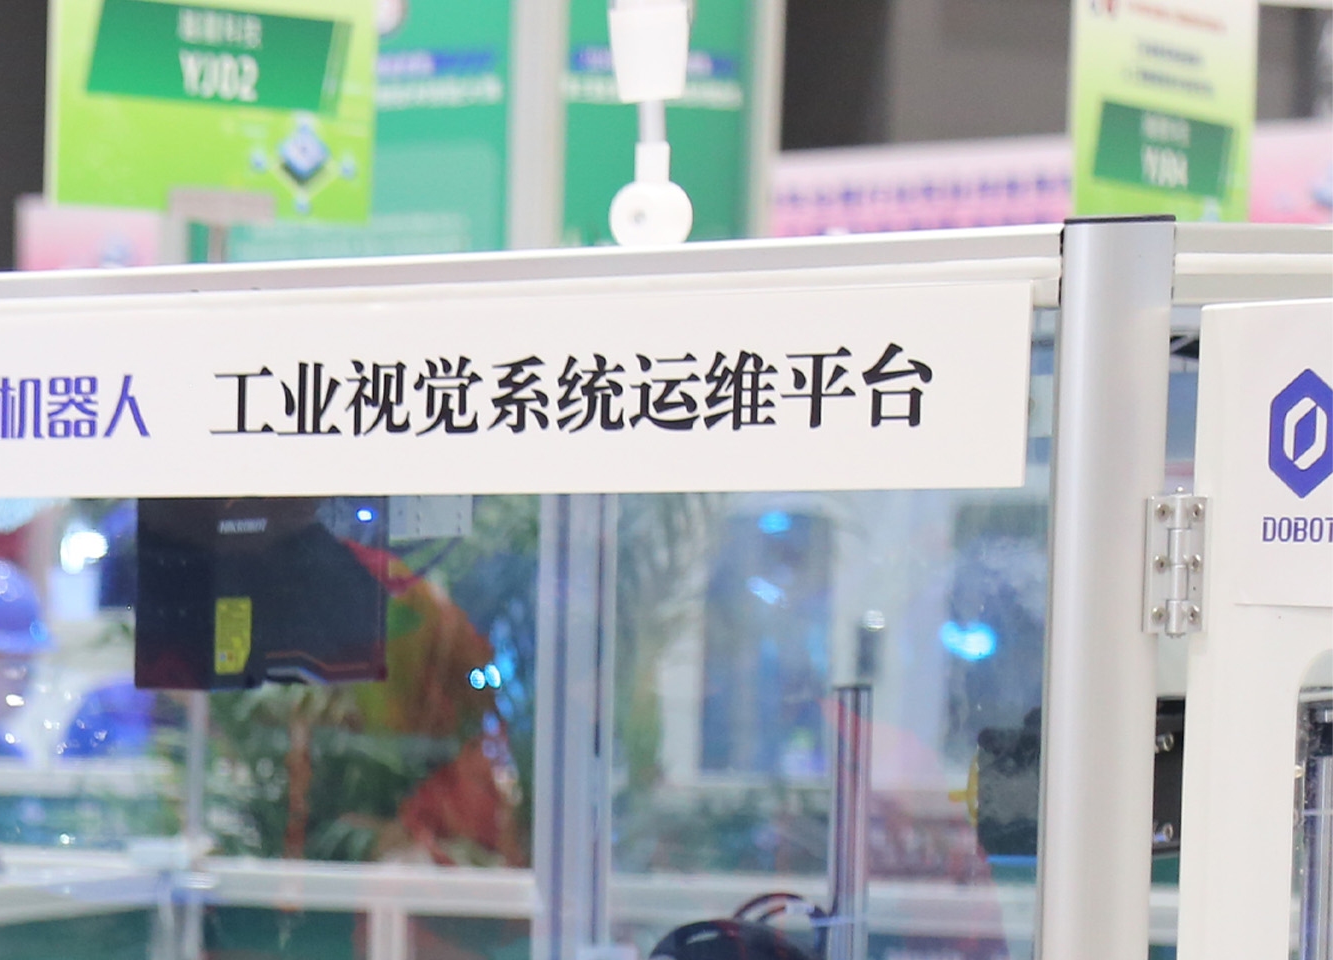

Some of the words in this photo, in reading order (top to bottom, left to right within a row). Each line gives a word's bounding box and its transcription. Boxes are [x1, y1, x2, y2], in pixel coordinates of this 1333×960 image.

[178, 49, 259, 102] YJ02
[209, 342, 934, 437] 工业视觉系统运维平台
